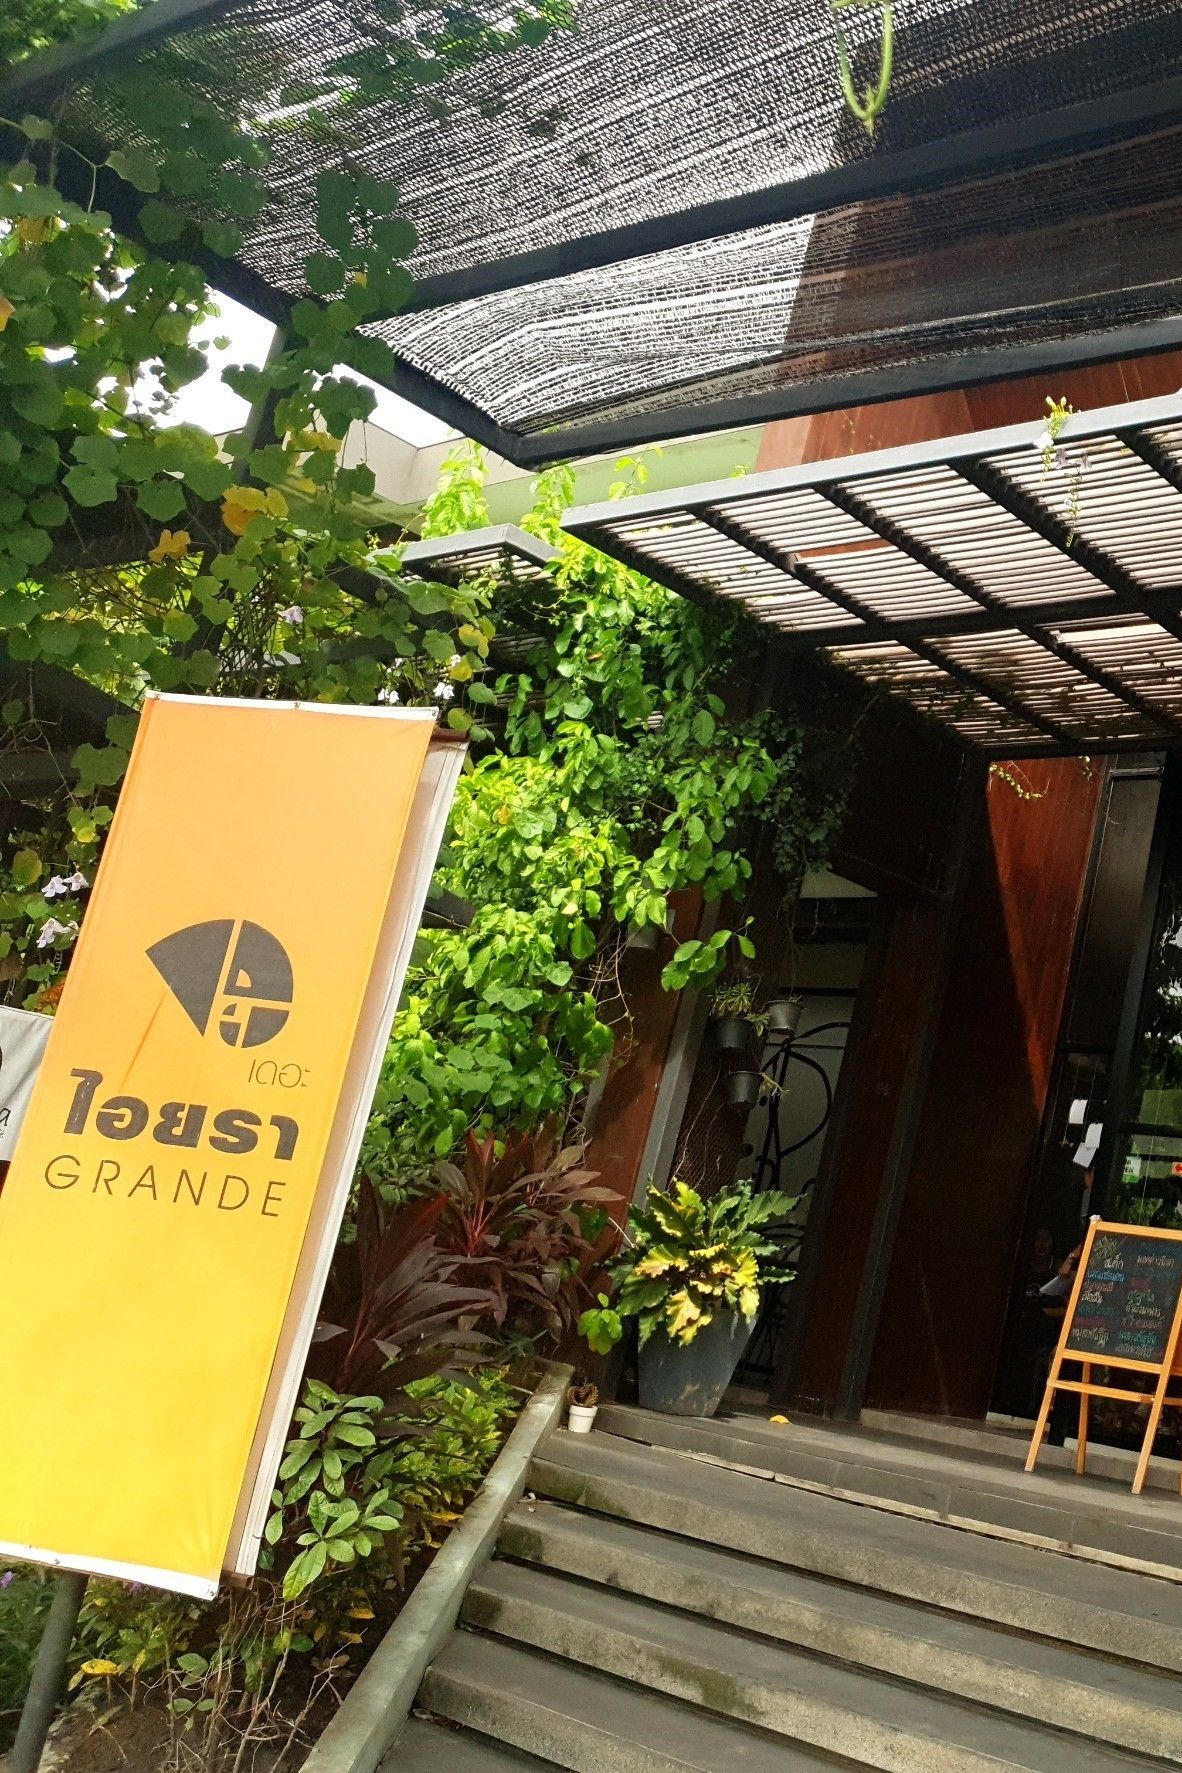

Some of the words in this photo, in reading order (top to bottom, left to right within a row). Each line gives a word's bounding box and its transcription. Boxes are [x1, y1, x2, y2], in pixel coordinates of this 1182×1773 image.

[247, 1059, 311, 1088] เดอะ
[63, 1068, 299, 1161] ไอยรา
[44, 1154, 287, 1217] GRANDE
